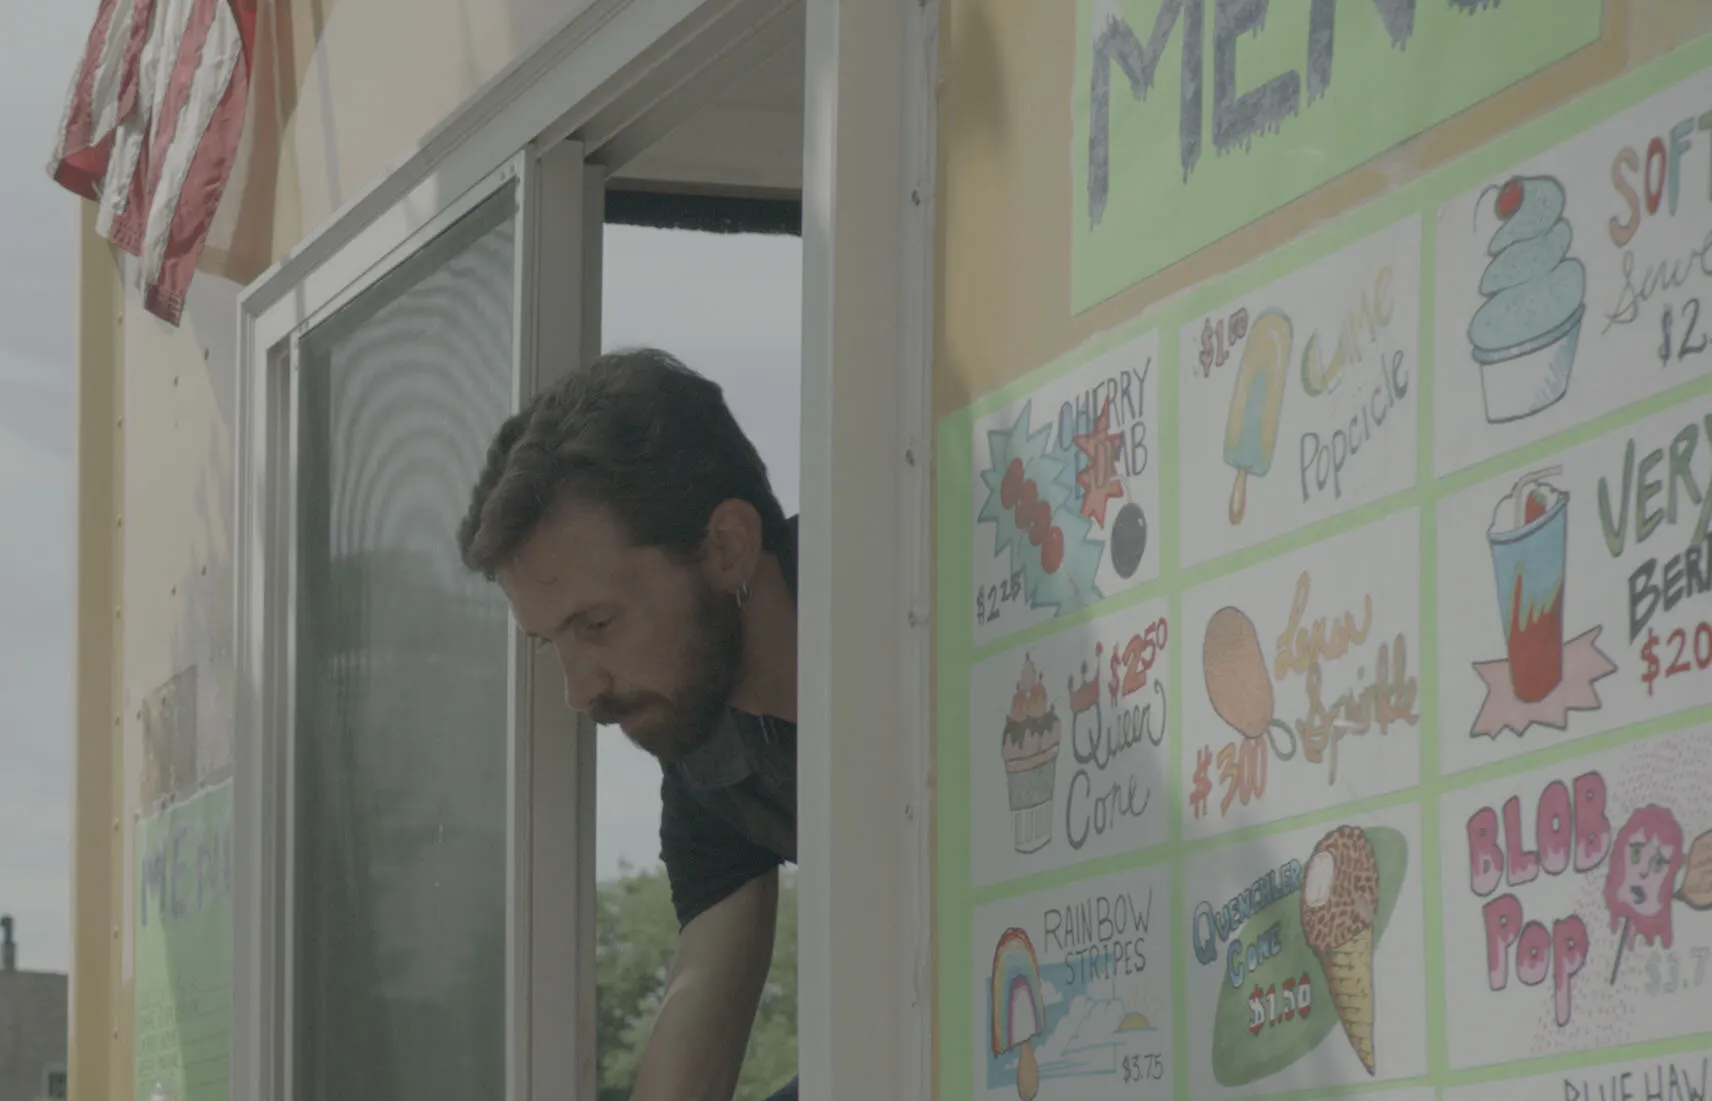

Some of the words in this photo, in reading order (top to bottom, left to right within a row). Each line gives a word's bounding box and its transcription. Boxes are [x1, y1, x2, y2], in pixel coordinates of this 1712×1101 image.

[1058, 356, 1151, 452] CHERRY
[1072, 678, 1167, 770] Queen
[1066, 769, 1150, 851] Cone
[1466, 770, 1611, 897] BLOB
[1044, 887, 1153, 953] RAINBOW
[1065, 937, 1147, 985] STRIPES
[1247, 972, 1312, 1036] $1.50
[1122, 1052, 1164, 1084] $3.75
